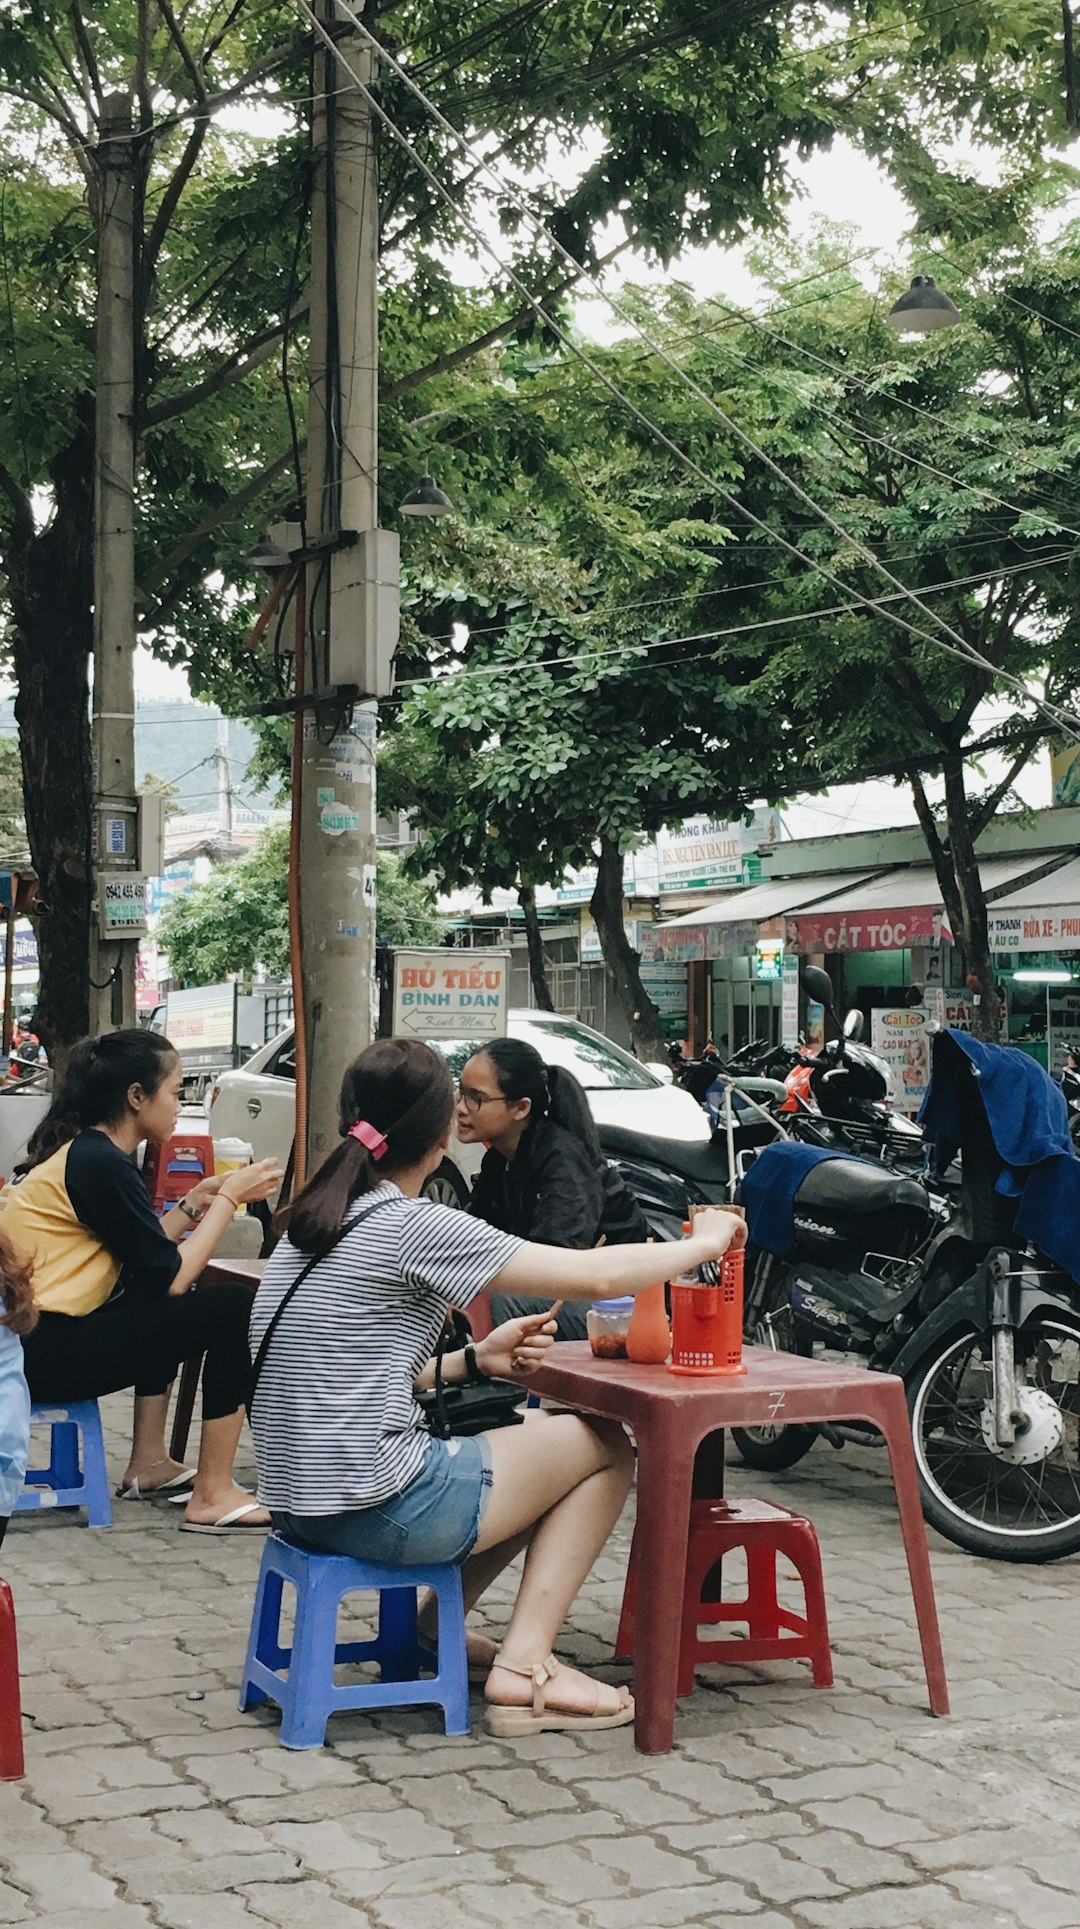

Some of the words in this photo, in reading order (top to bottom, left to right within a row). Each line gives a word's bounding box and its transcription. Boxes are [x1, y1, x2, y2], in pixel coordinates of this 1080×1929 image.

[824, 918, 862, 949] CẮT
[867, 919, 906, 947] TÓC
[1042, 919, 1053, 937] XE
[401, 960, 437, 988] HỦ
[442, 961, 502, 990] TIẾU
[402, 990, 450, 1006] BÌNH
[459, 991, 499, 1007] DÂN
[801, 1297, 841, 1326] Super
[768, 1391, 786, 1418] 7
